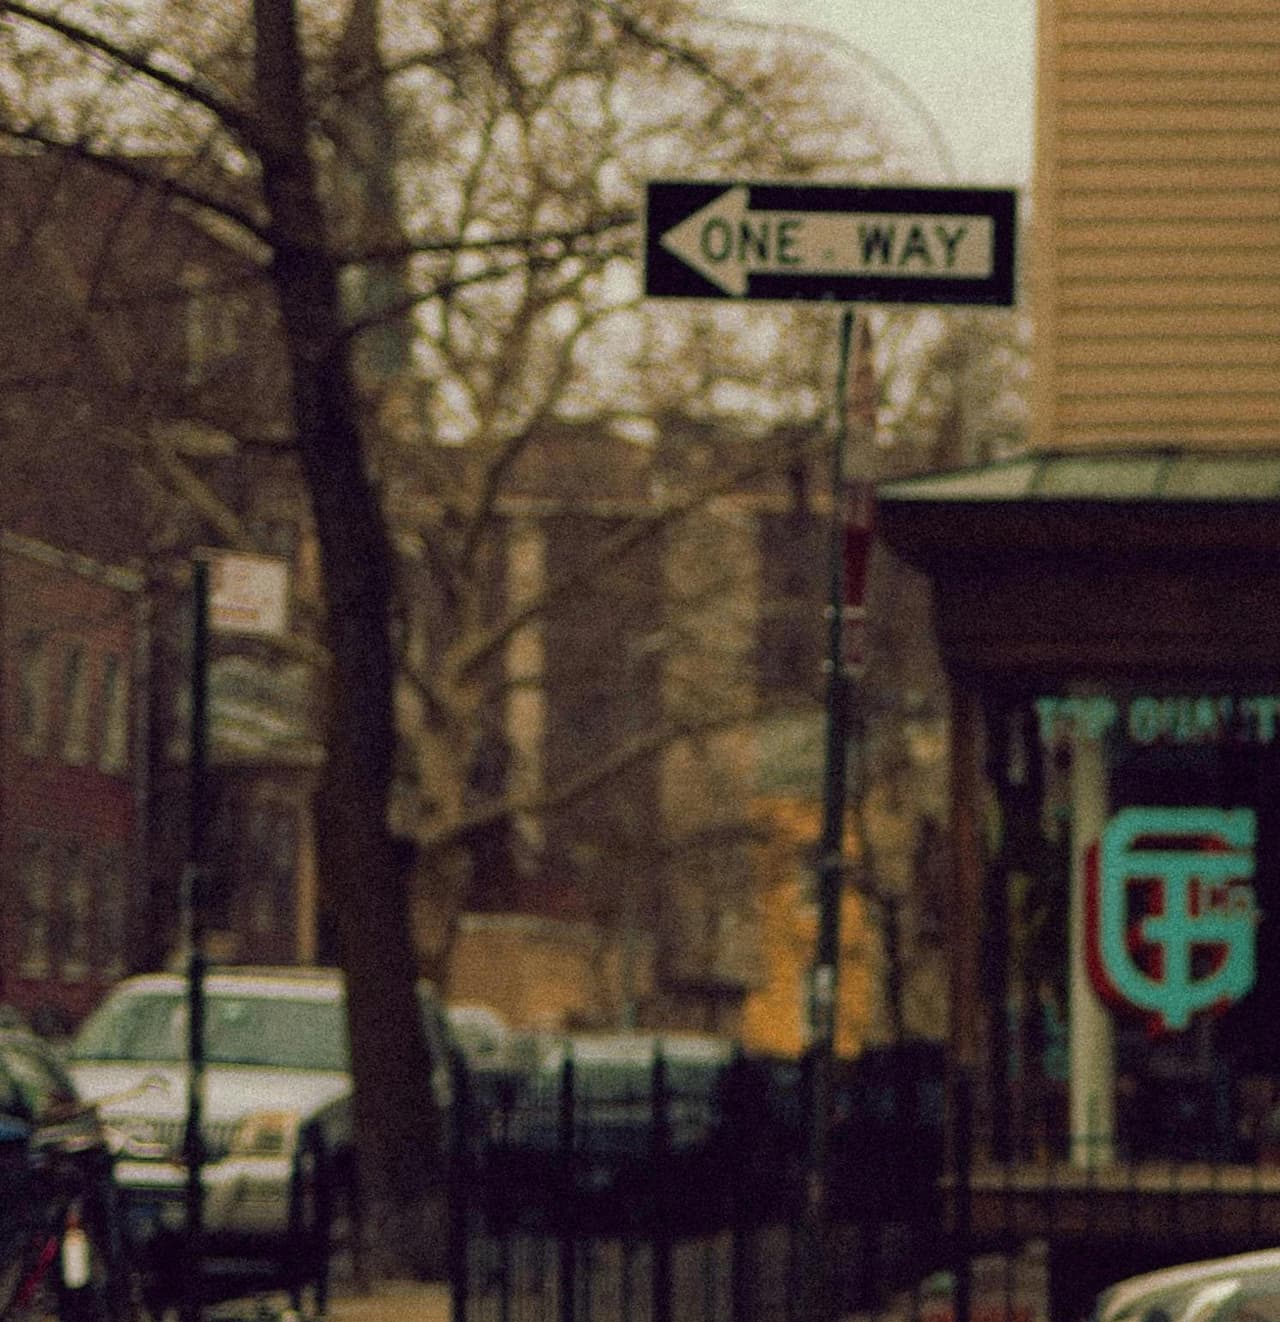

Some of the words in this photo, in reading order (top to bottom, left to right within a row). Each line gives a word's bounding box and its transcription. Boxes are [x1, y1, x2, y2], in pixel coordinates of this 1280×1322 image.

[702, 218, 801, 264] ONE
[859, 223, 966, 267] WAY
[1035, 696, 1118, 742] TOP
